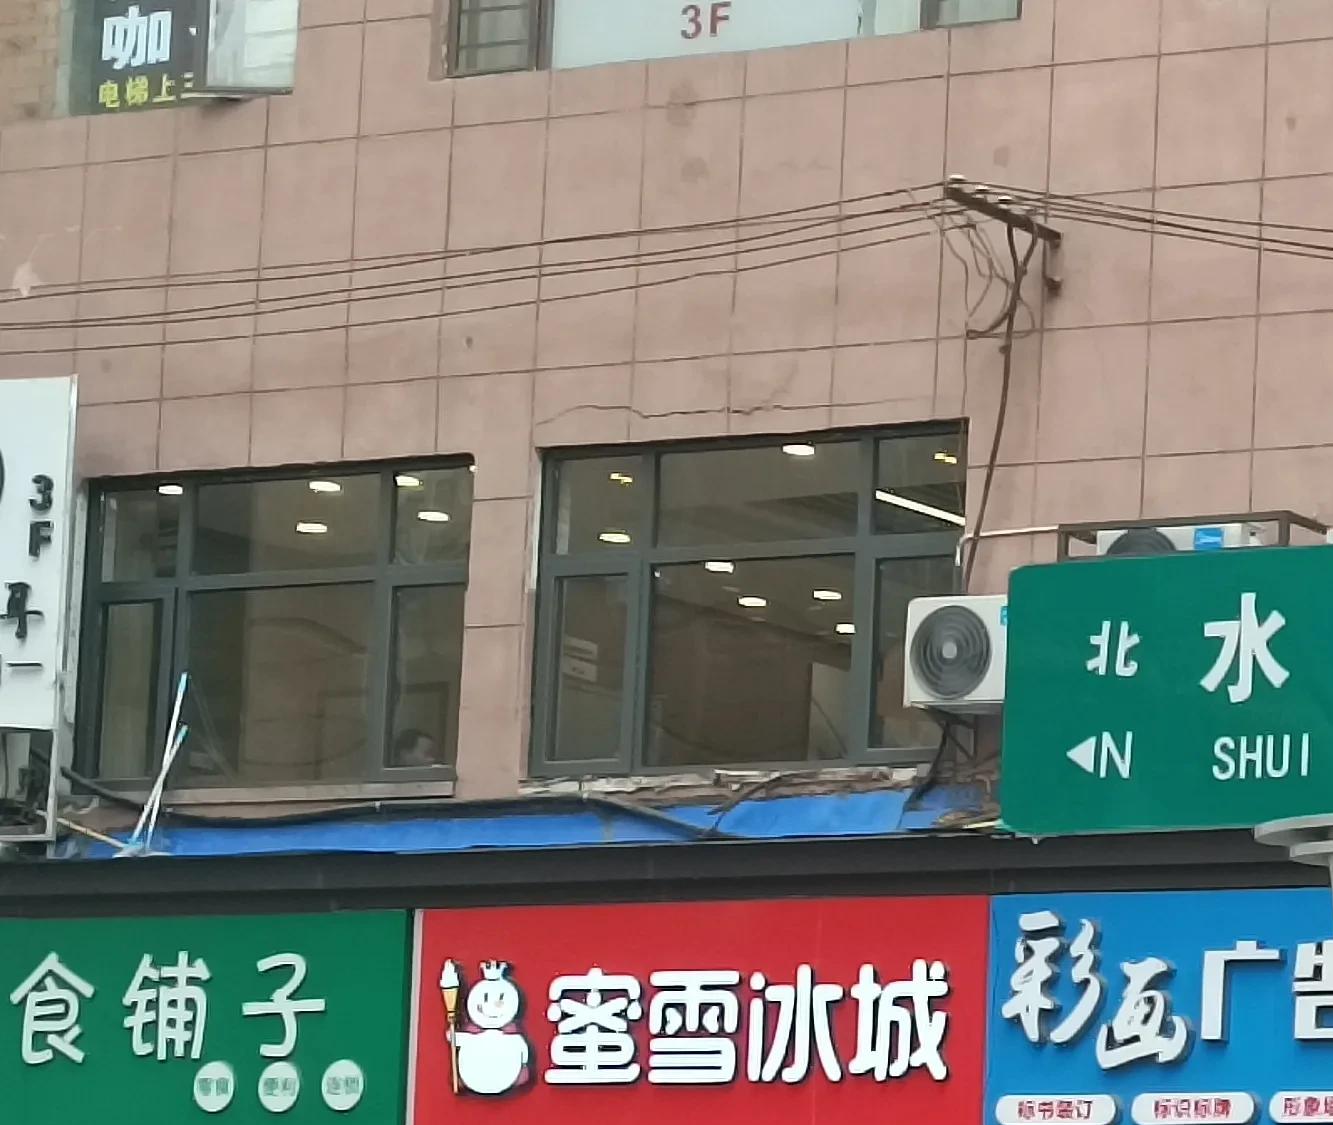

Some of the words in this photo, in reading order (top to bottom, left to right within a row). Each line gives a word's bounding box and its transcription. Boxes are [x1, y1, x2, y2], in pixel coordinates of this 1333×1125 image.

[101, 5, 198, 69] 咖
[680, 4, 731, 39] 3F
[1087, 620, 1140, 677] 北
[1200, 592, 1289, 703] 水
[1099, 731, 1133, 779] N
[1212, 733, 1310, 780] SHUI
[8, 950, 326, 1065] 食铺子
[544, 959, 950, 1084] 蜜雪冰城
